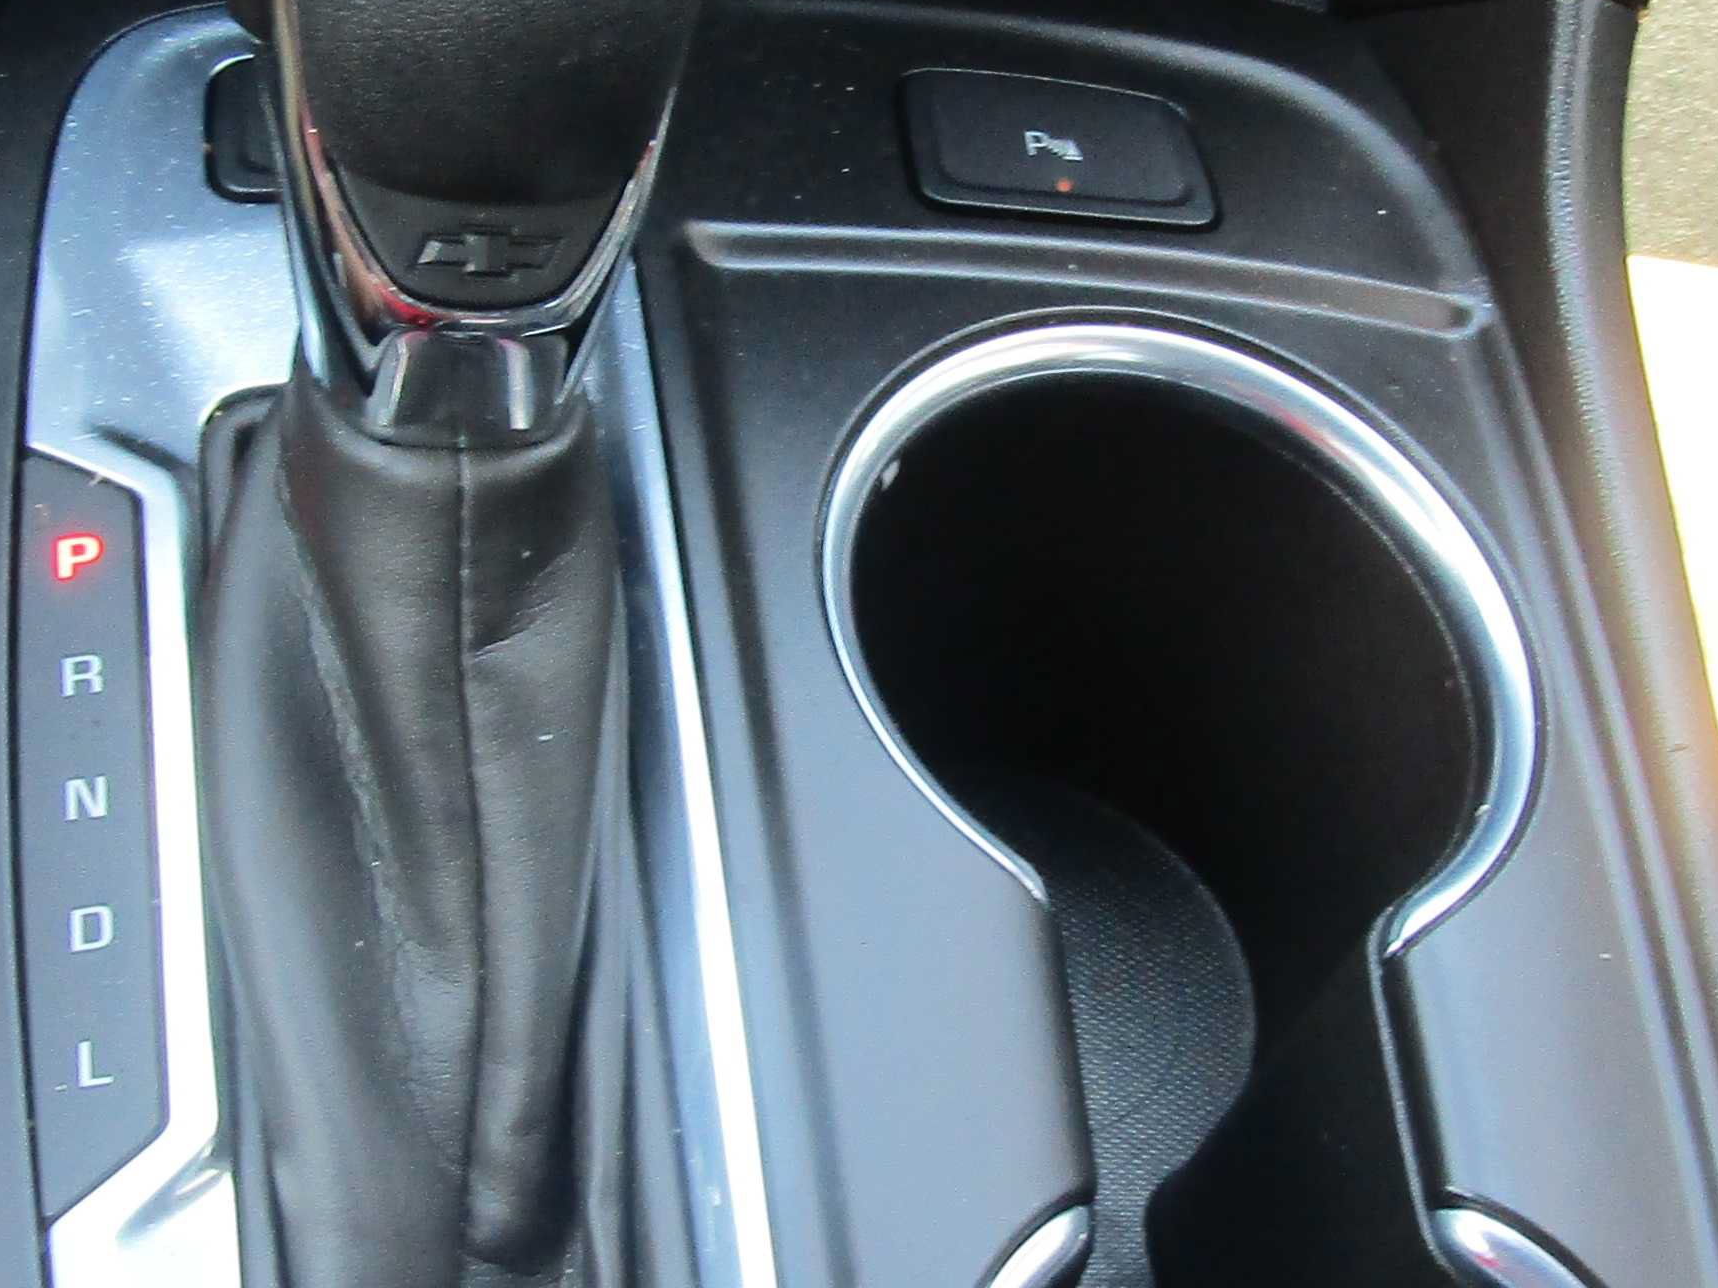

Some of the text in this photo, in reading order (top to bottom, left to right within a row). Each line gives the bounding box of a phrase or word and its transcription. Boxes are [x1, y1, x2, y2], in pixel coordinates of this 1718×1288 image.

[54, 533, 103, 579] P
[60, 654, 103, 697] R
[64, 775, 109, 821] N
[69, 905, 114, 952] D
[78, 1040, 114, 1089] L
